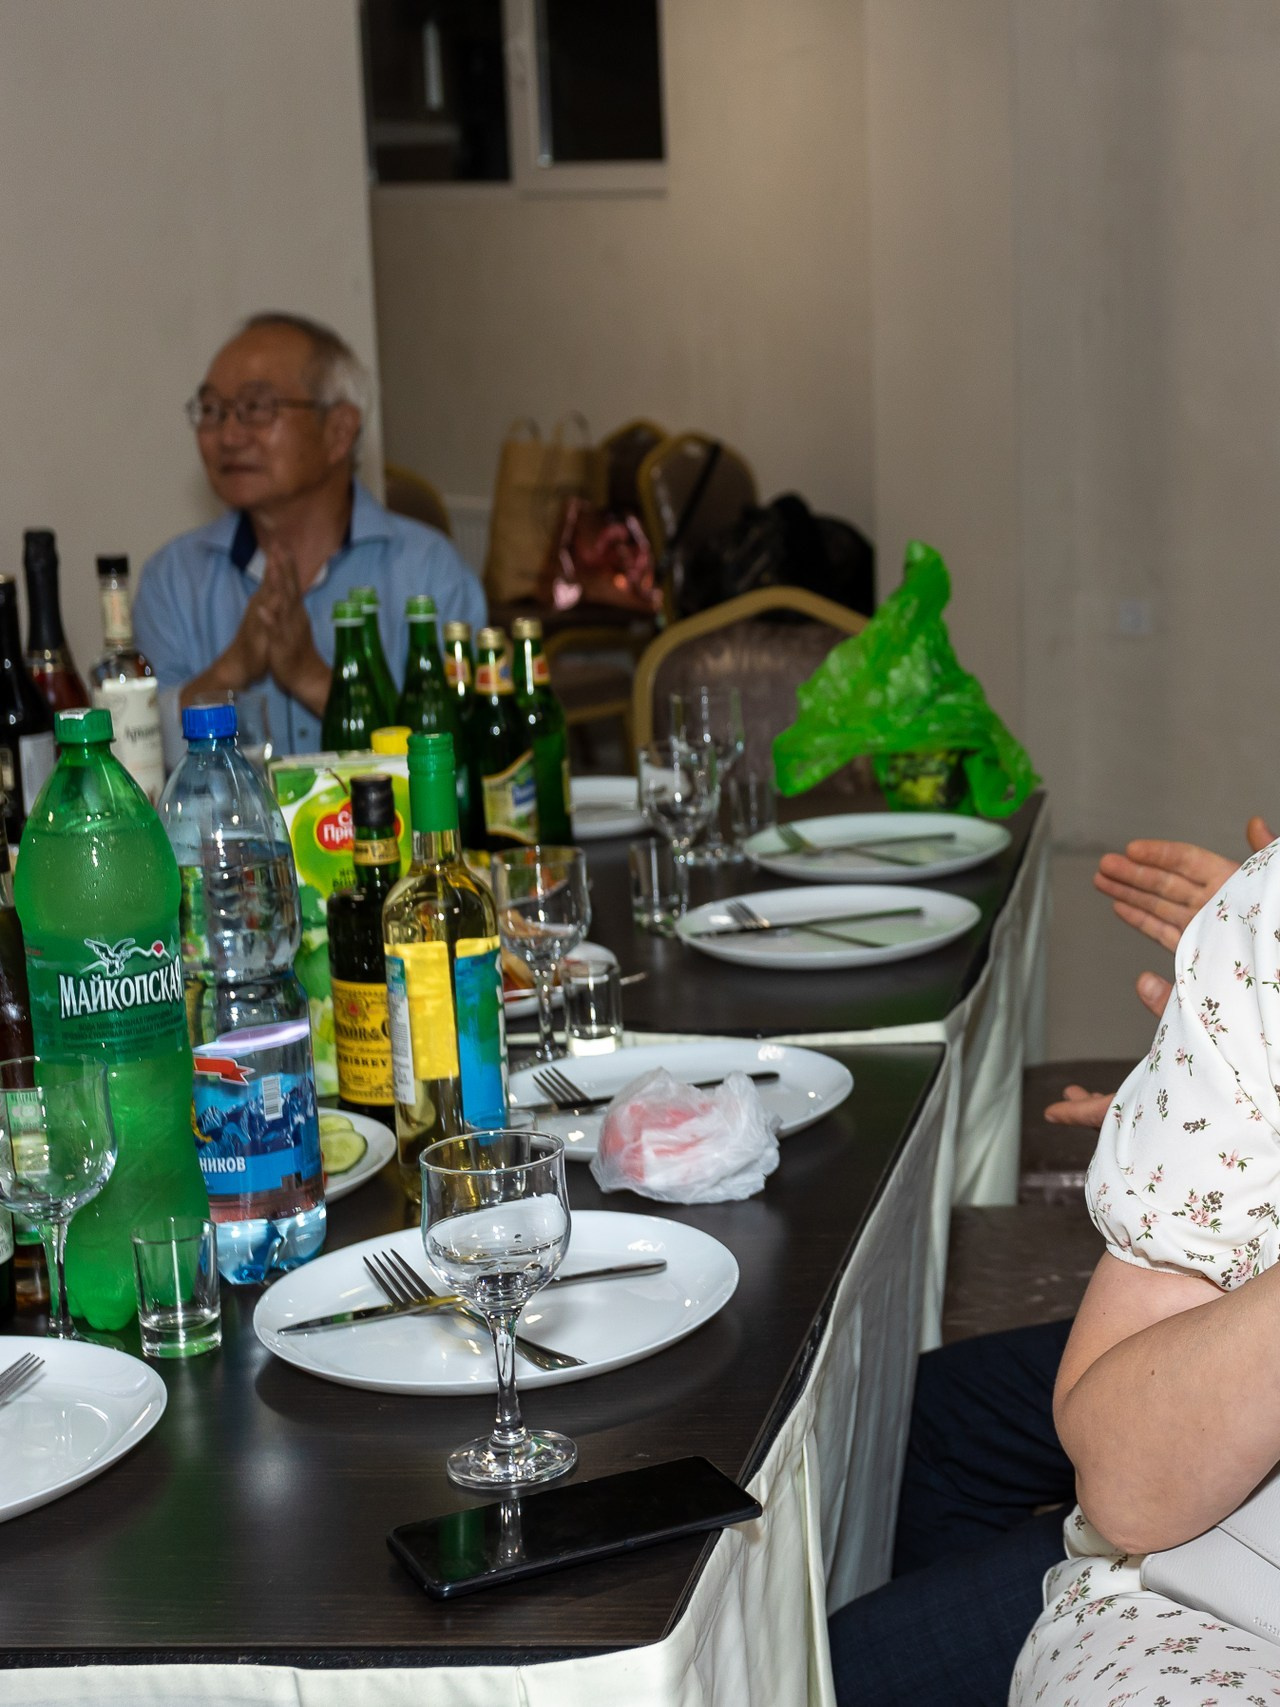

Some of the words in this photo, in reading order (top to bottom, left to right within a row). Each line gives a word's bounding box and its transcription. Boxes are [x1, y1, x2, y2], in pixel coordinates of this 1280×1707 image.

[323, 823, 354, 844] При
[59, 955, 183, 1019] МАЙКОПСКАЯ
[199, 1156, 246, 1173] НИКОВ
